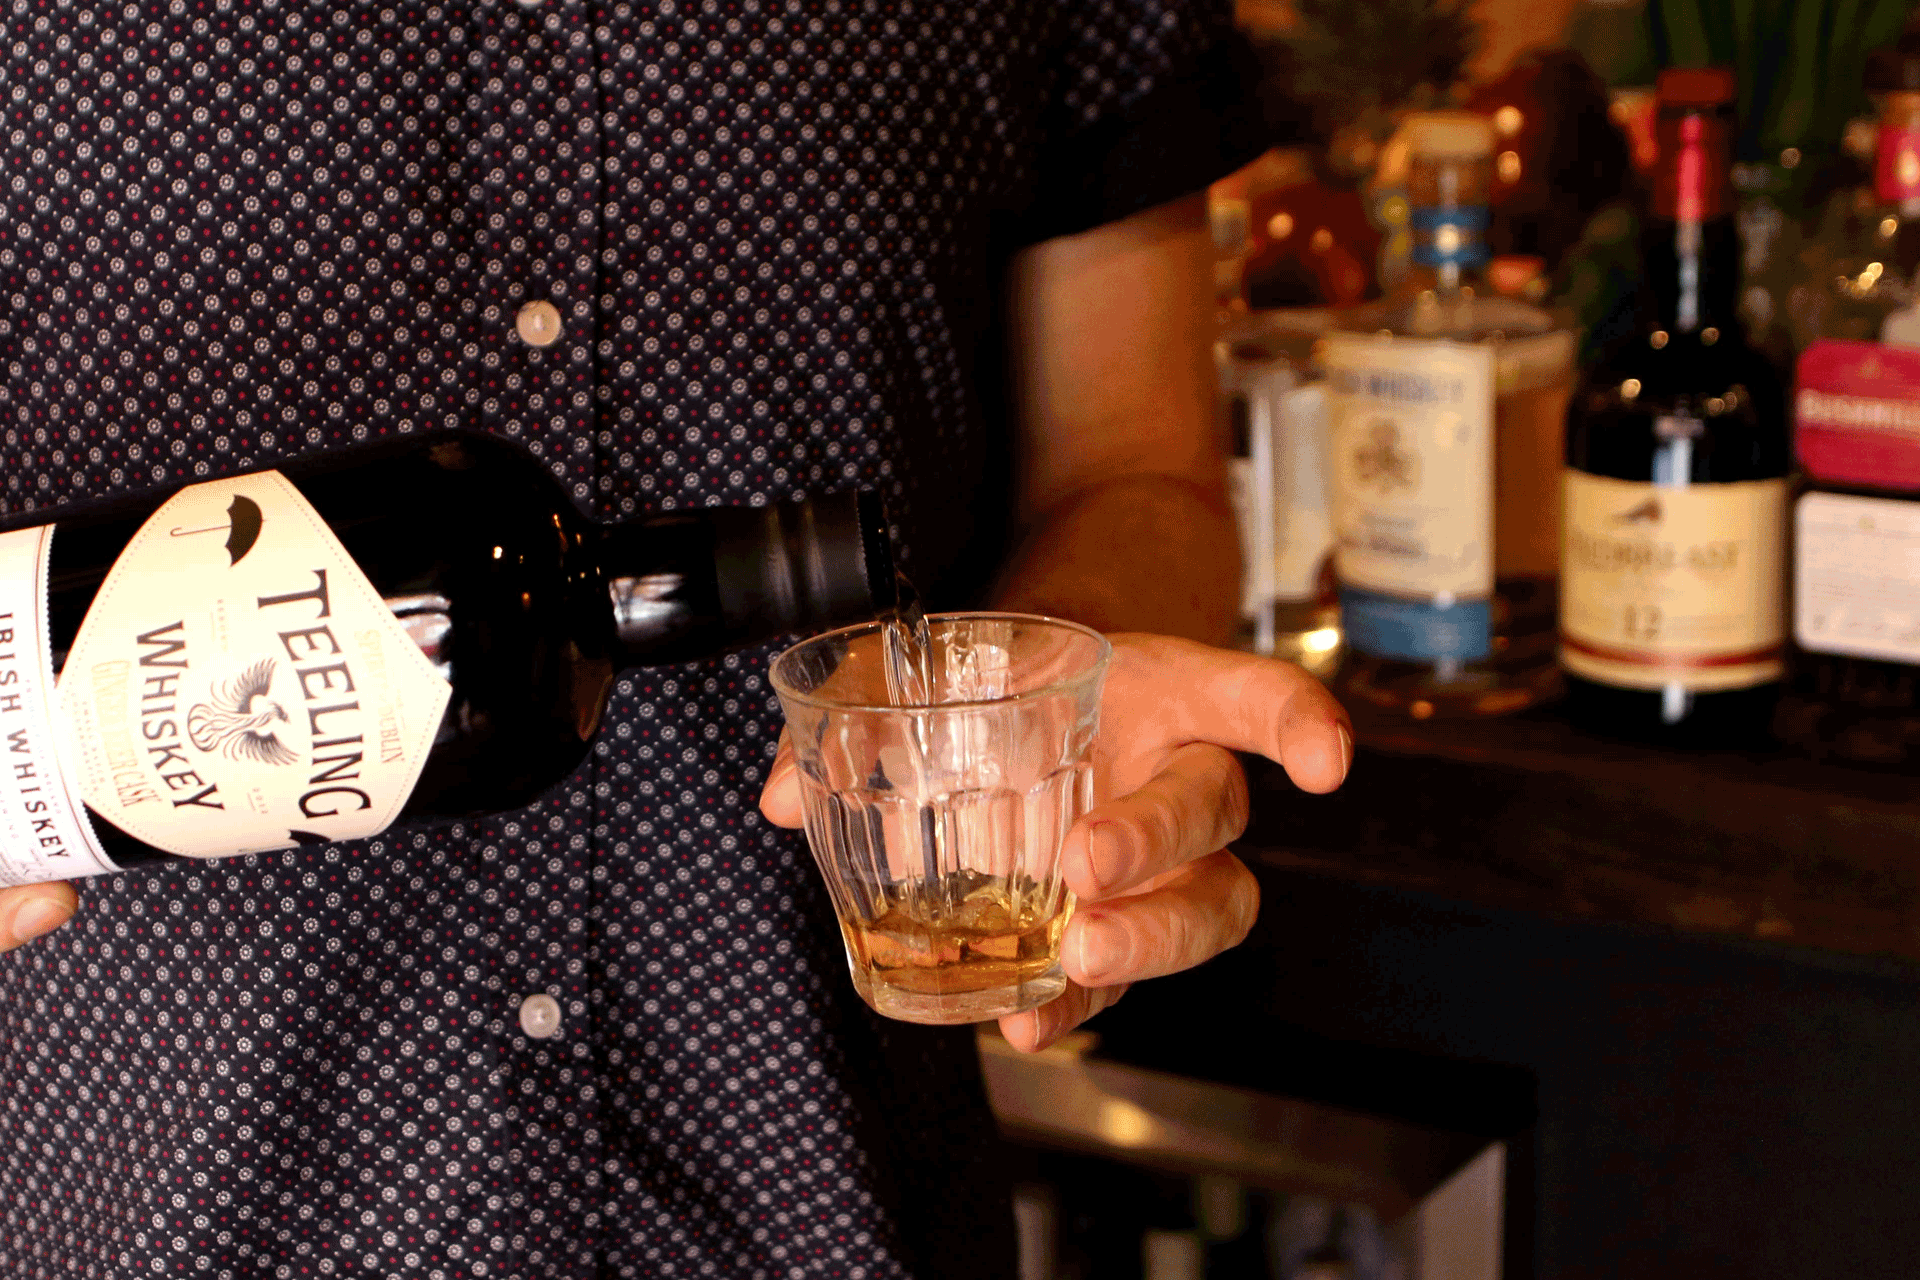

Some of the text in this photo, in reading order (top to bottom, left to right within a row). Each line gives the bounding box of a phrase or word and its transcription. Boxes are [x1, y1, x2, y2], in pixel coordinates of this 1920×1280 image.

[135, 619, 226, 811] WHISKEY
[256, 568, 372, 819] TEELING
[6, 728, 71, 859] WHISKEY
